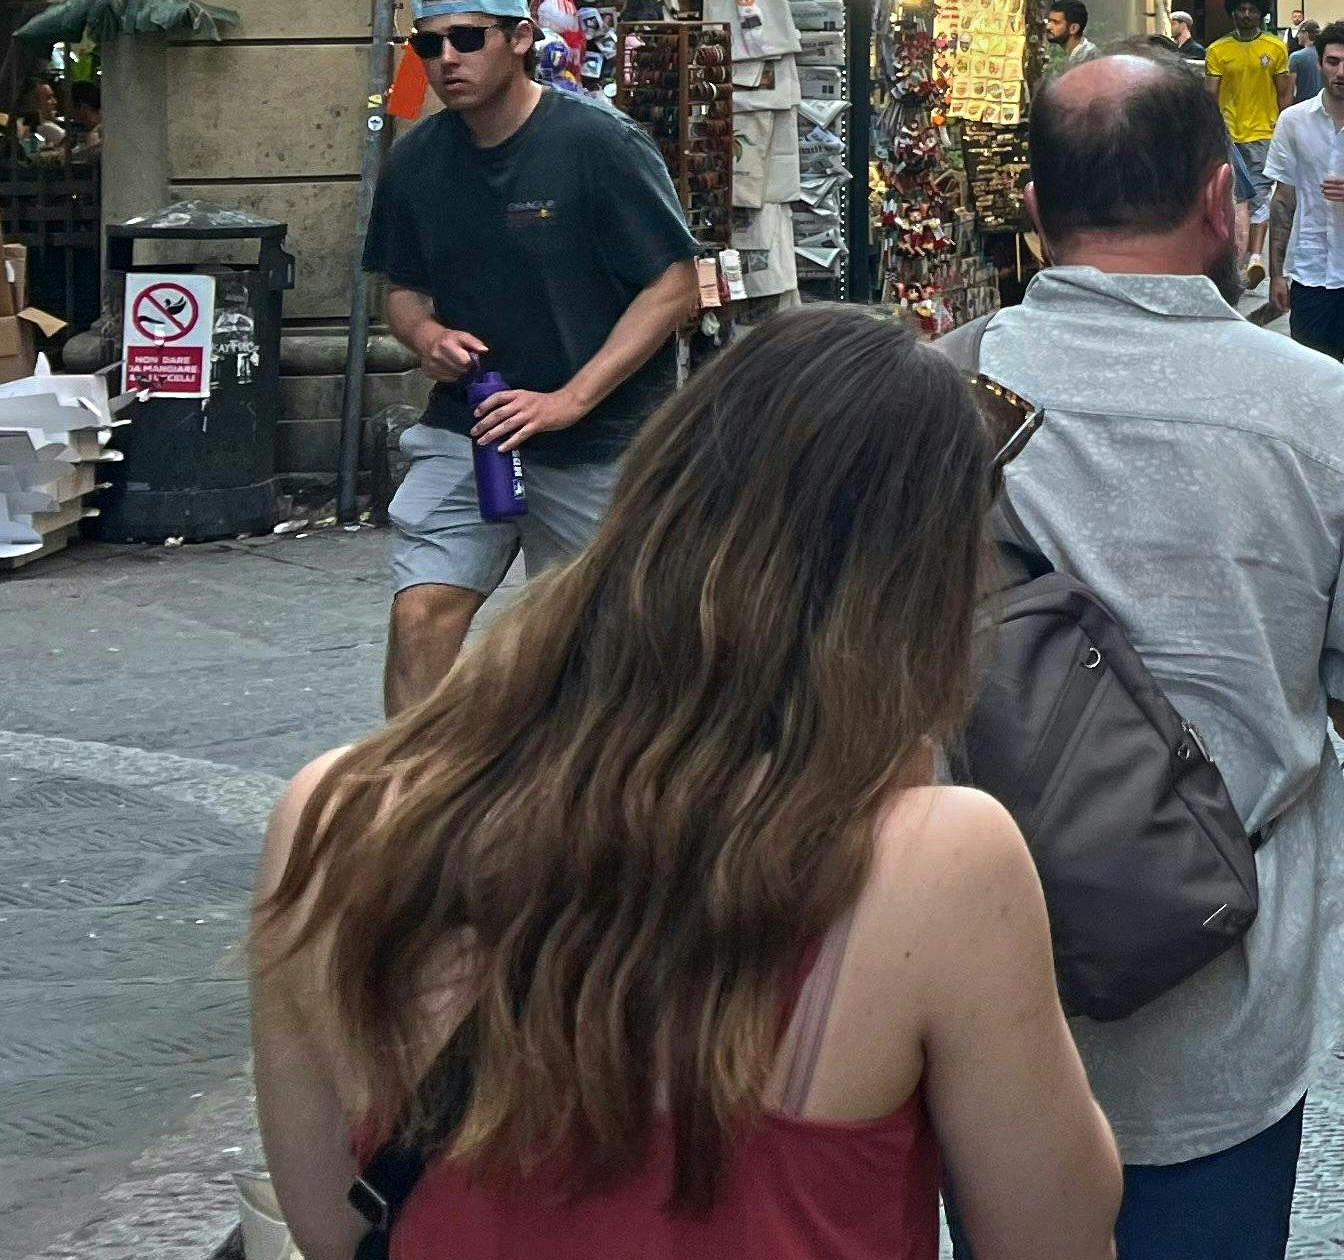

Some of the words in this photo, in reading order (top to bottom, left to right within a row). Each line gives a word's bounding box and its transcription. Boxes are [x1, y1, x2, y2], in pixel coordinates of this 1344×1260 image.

[134, 356, 158, 364] NON
[162, 356, 190, 365] DARE
[143, 365, 198, 374] MANGIARE
